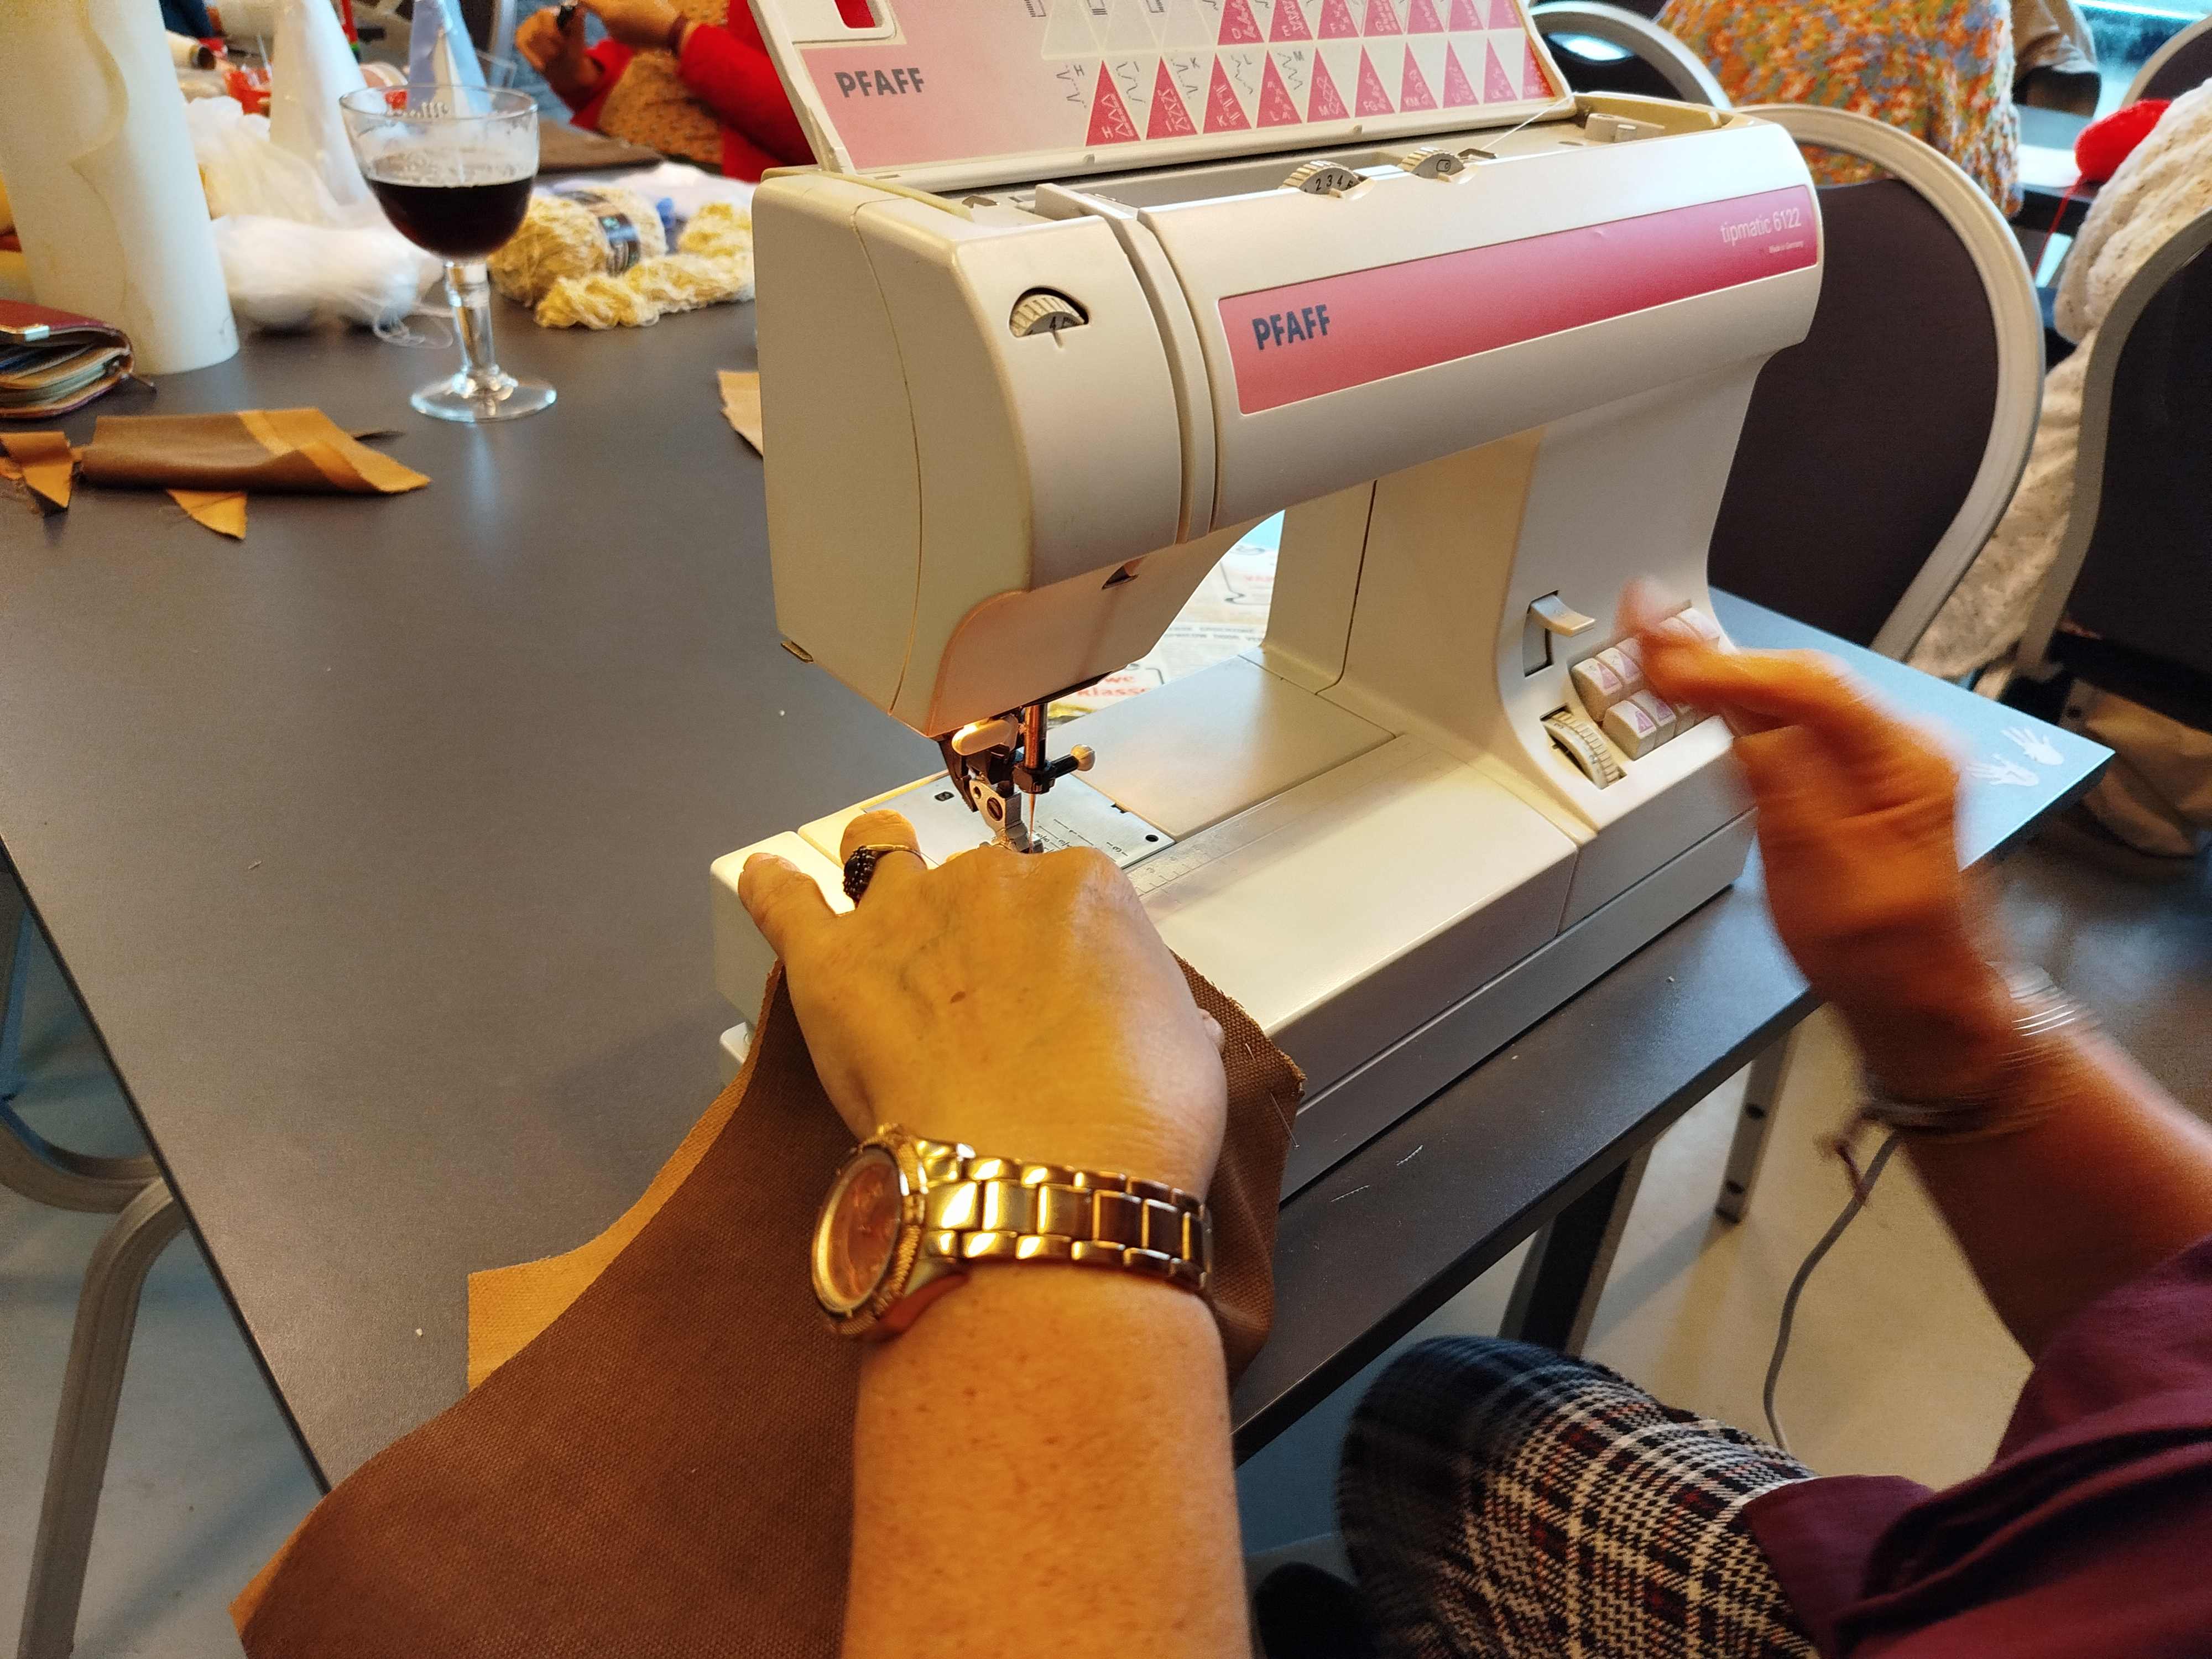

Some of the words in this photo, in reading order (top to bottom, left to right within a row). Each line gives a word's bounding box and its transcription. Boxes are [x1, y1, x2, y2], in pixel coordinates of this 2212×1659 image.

[1073, 65, 1084, 76] H
[1190, 57, 1200, 69] K
[834, 67, 925, 98] PFAFF
[1101, 126, 1114, 138] H
[1217, 114, 1227, 127] K
[1270, 111, 1280, 122] L
[1315, 178, 1322, 191] 2
[1326, 174, 1333, 187] 3
[1337, 174, 1343, 187] 4
[1720, 215, 1772, 247] tipmatic
[1773, 207, 1802, 231] 6122
[1252, 304, 1331, 350] PFAFF
